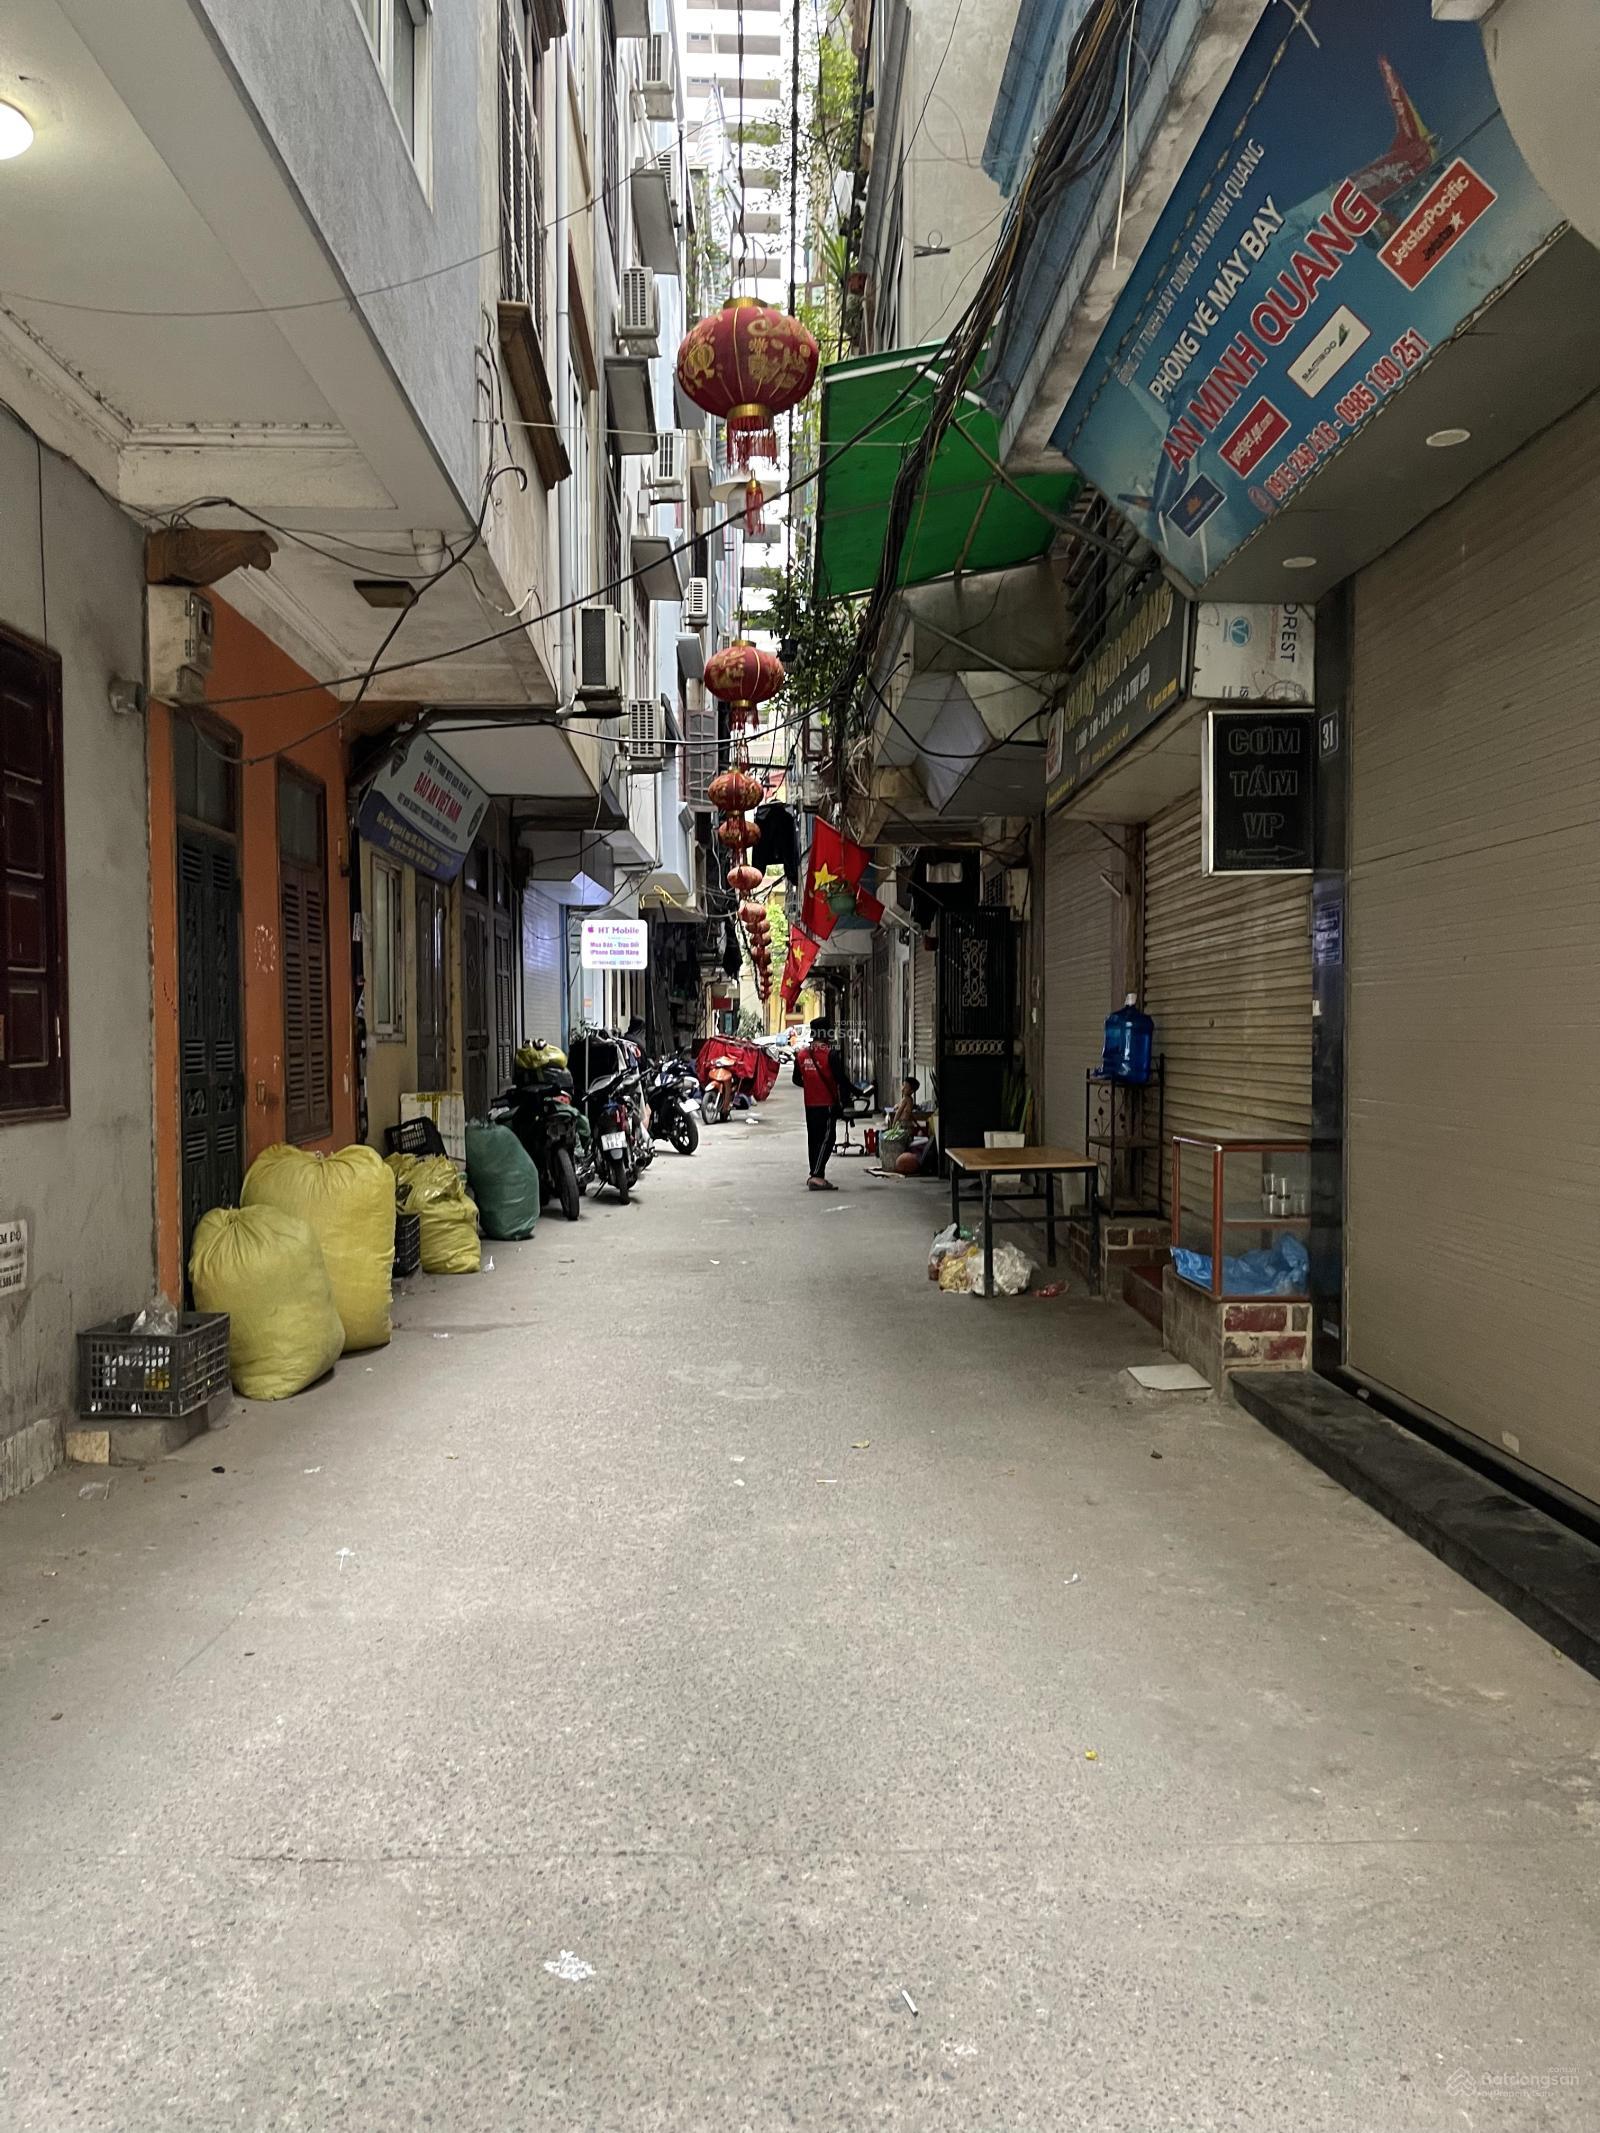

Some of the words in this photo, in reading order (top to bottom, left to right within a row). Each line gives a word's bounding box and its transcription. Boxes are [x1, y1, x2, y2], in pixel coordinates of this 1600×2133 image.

[1155, 288, 1177, 324] XÂY
[1191, 227, 1212, 260] AN
[1202, 194, 1234, 240] MINH
[1224, 138, 1265, 199] QUANG
[1391, 175, 1470, 266] JetstarPacific
[1149, 329, 1201, 404] PHÒNG
[1187, 297, 1219, 338] VÉ
[1207, 248, 1251, 311] MÁY
[1240, 195, 1286, 263] BAY
[1162, 414, 1207, 475] AN
[1187, 331, 1268, 433] MINH
[1250, 177, 1382, 347] QUANG
[1334, 380, 1378, 426] 0985
[1366, 355, 1404, 395] 190
[1391, 326, 1431, 371] 251
[1228, 726, 1300, 755] CƠM
[1322, 719, 1334, 750] 31
[1242, 812, 1285, 838] VP
[598, 926, 609, 934] HT
[612, 926, 640, 934] Mobile
